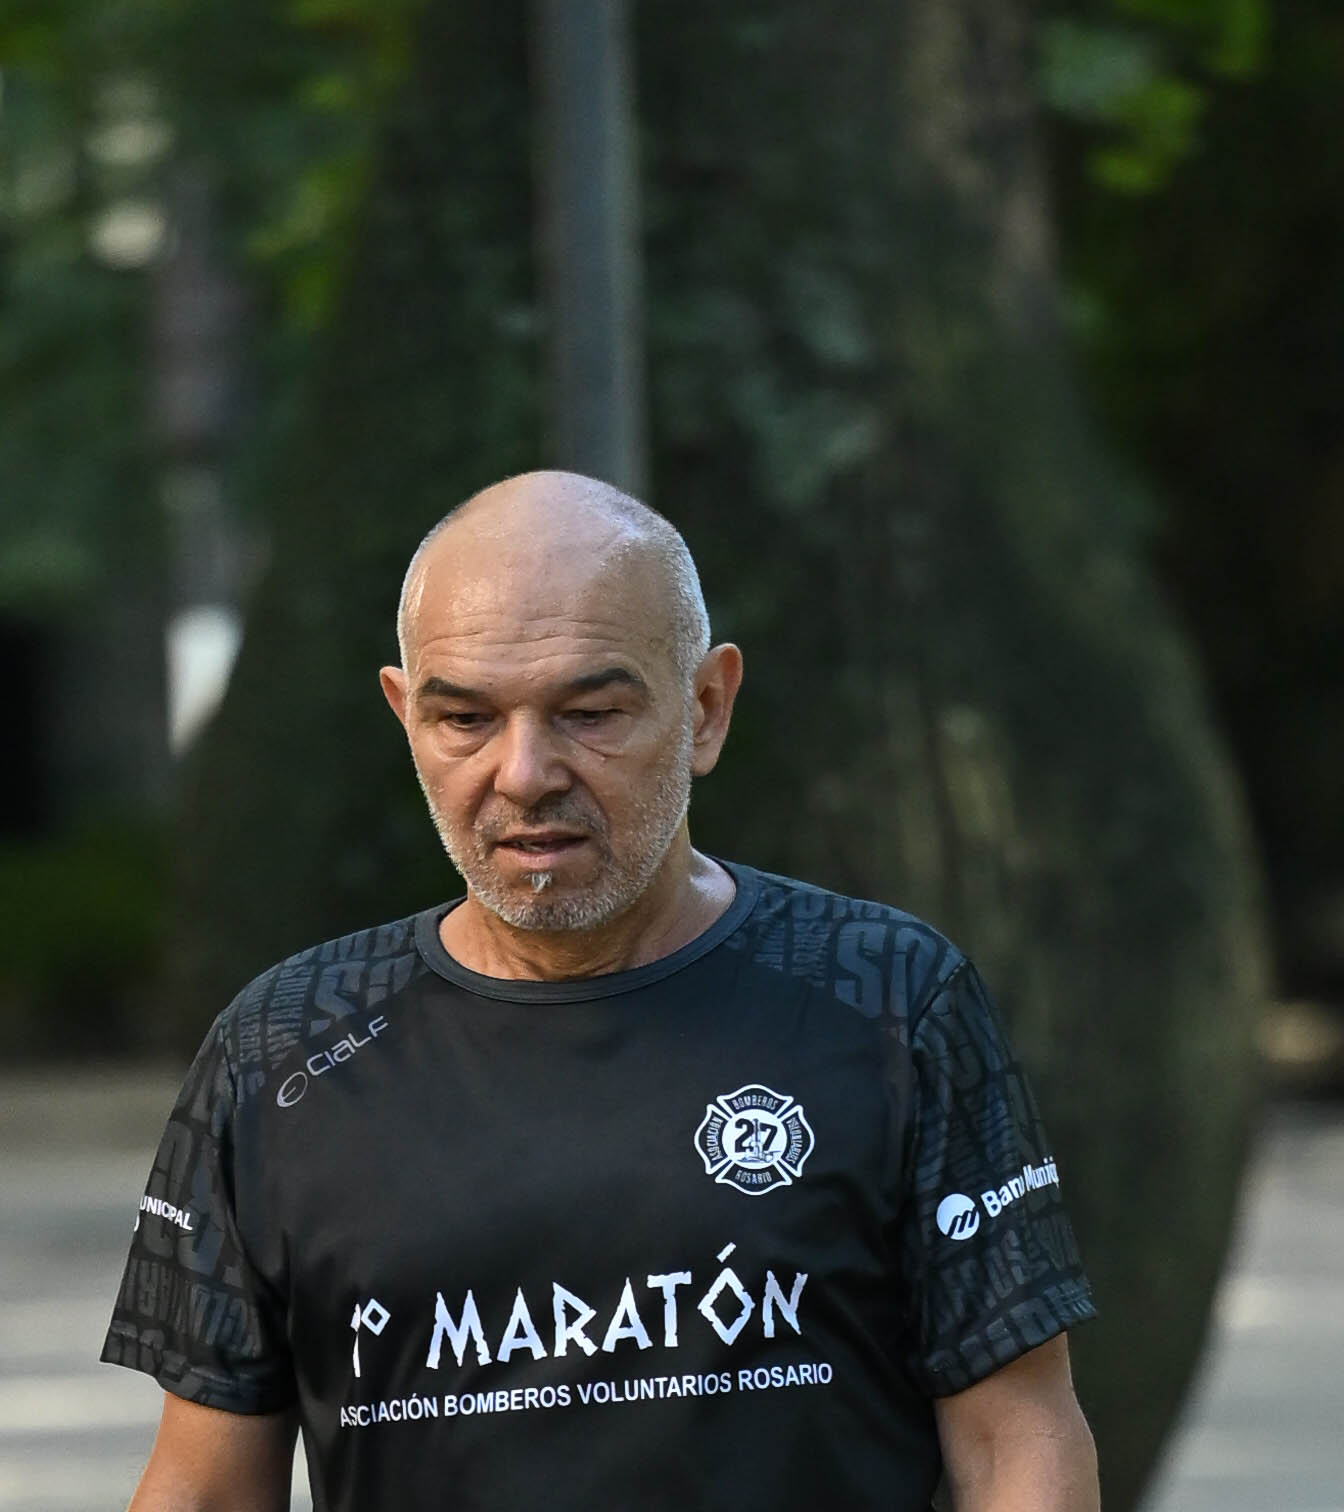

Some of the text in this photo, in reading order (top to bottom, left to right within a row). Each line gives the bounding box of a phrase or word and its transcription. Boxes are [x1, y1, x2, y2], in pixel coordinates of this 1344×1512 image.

[733, 1117, 779, 1155] 27
[425, 1242, 809, 1369] MARATÓN
[444, 1383, 572, 1418] BOMBEROS
[577, 1371, 733, 1406] VOLUNTARIOS
[738, 1362, 834, 1391] ROSARIO
